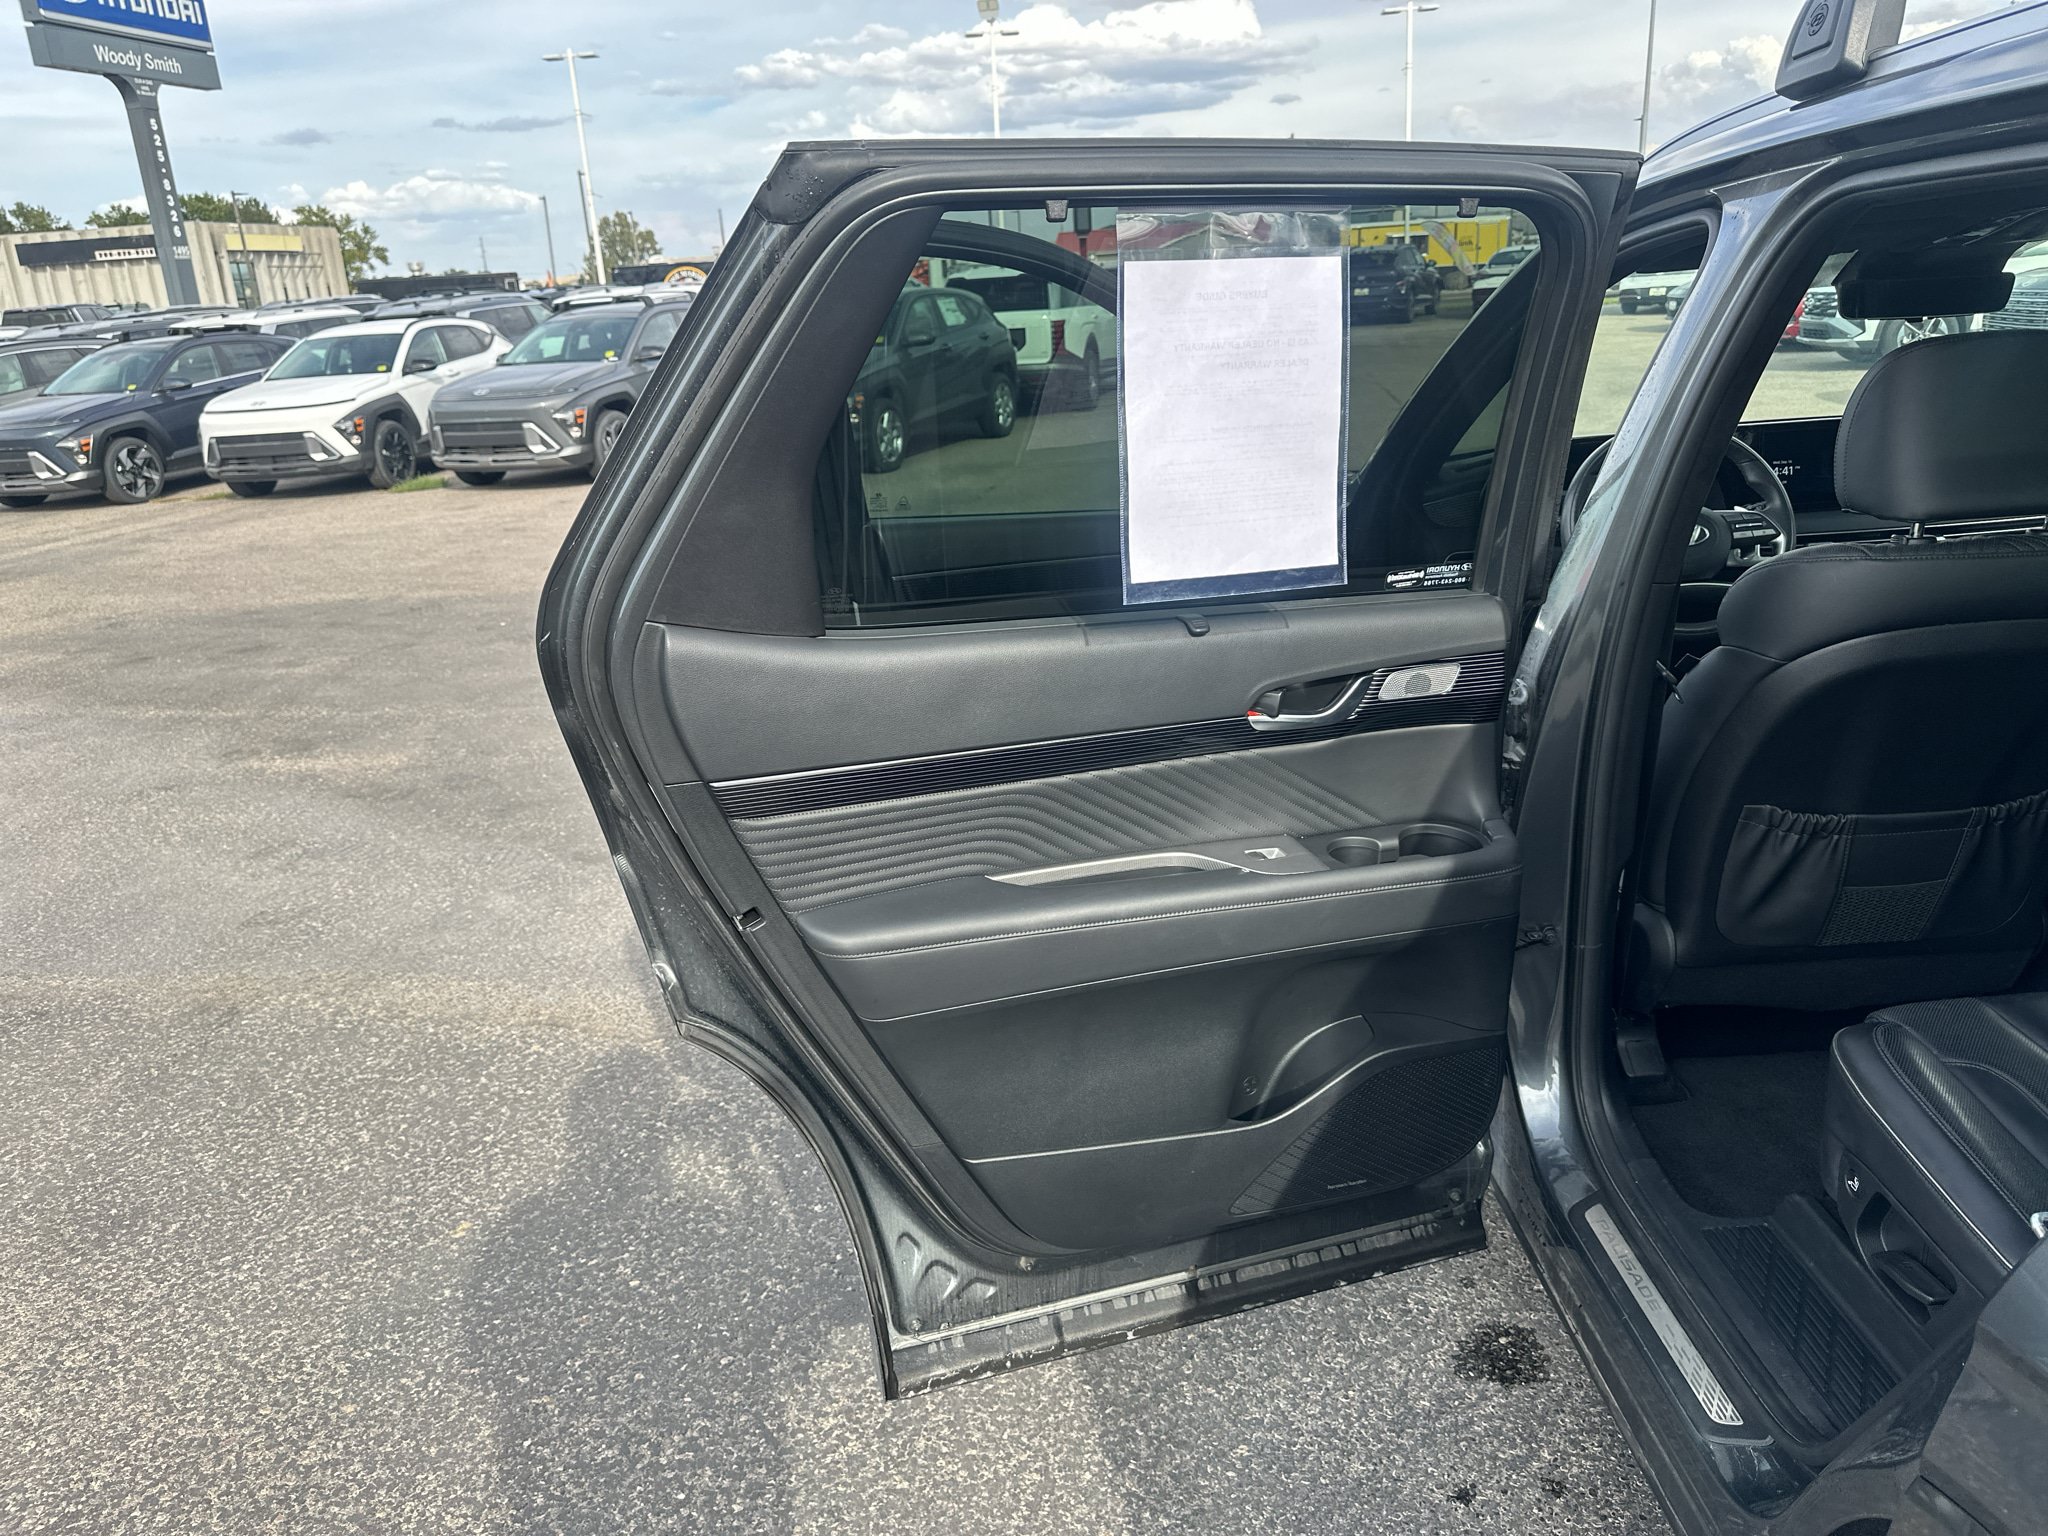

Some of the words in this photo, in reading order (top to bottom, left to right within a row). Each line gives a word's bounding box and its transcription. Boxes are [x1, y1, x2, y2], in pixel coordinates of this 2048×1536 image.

[98, 0, 203, 25] UNDAI
[93, 44, 141, 71] Woody
[144, 53, 182, 74] Smith
[1773, 465, 1793, 475] 4:41
[1595, 1219, 1662, 1311] PALISADE
